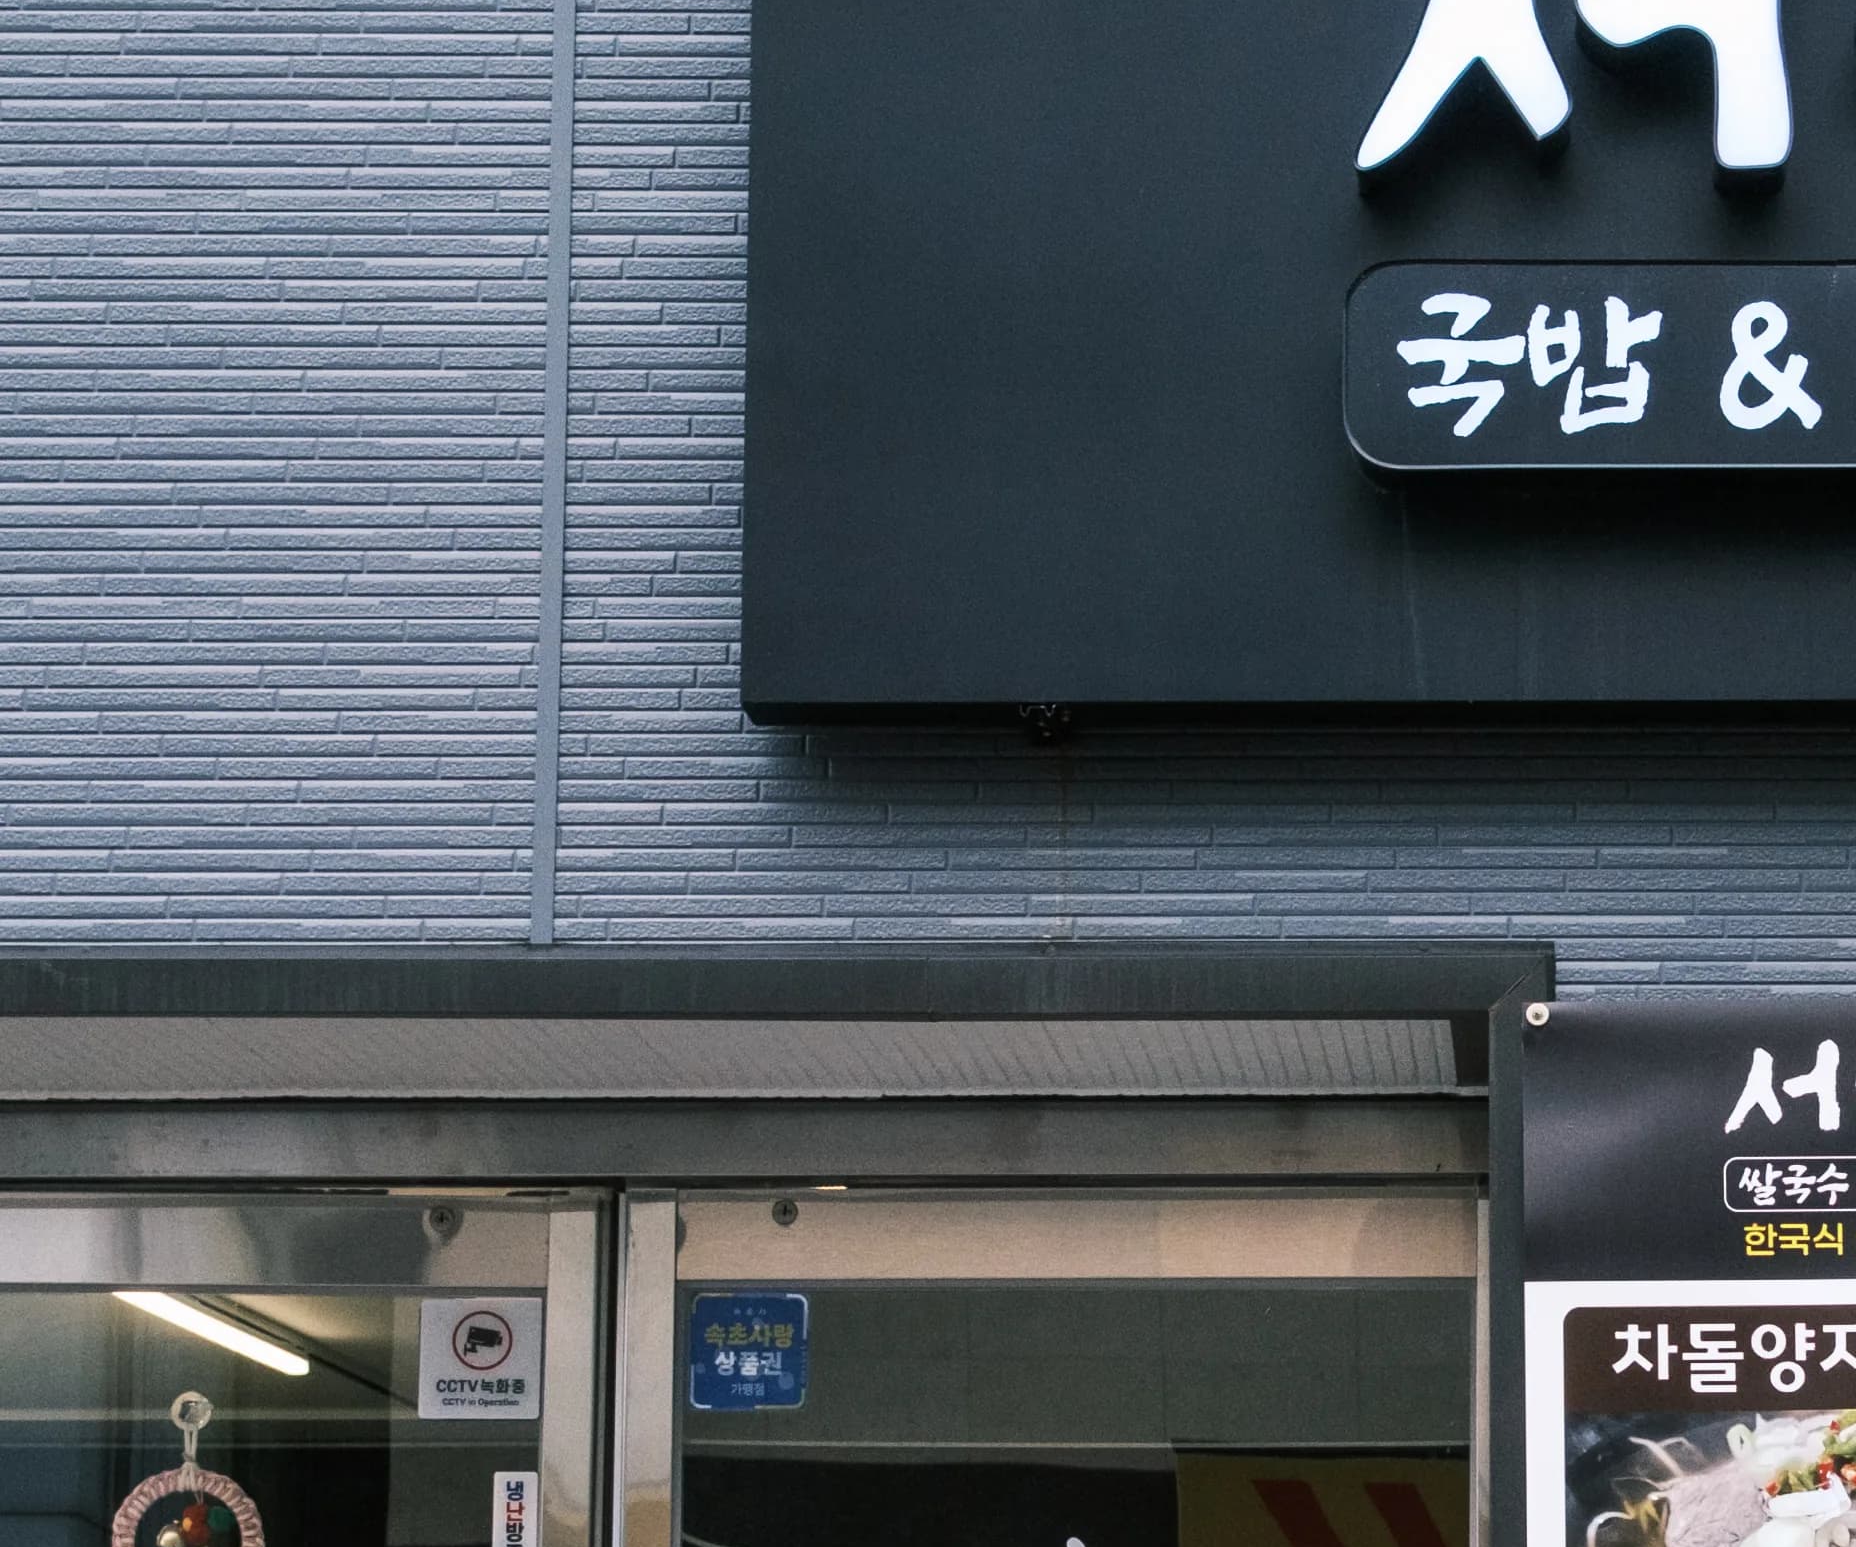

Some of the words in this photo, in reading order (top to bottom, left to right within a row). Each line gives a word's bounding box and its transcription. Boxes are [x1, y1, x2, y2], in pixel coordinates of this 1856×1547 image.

[1397, 292, 1663, 437] 국밥
[1718, 300, 1823, 430] &
[1738, 1165, 1851, 1207] 쌀국수
[1743, 1222, 1845, 1257] 한국식
[703, 1322, 795, 1349] 속초사랑
[714, 1350, 783, 1377] 상품권
